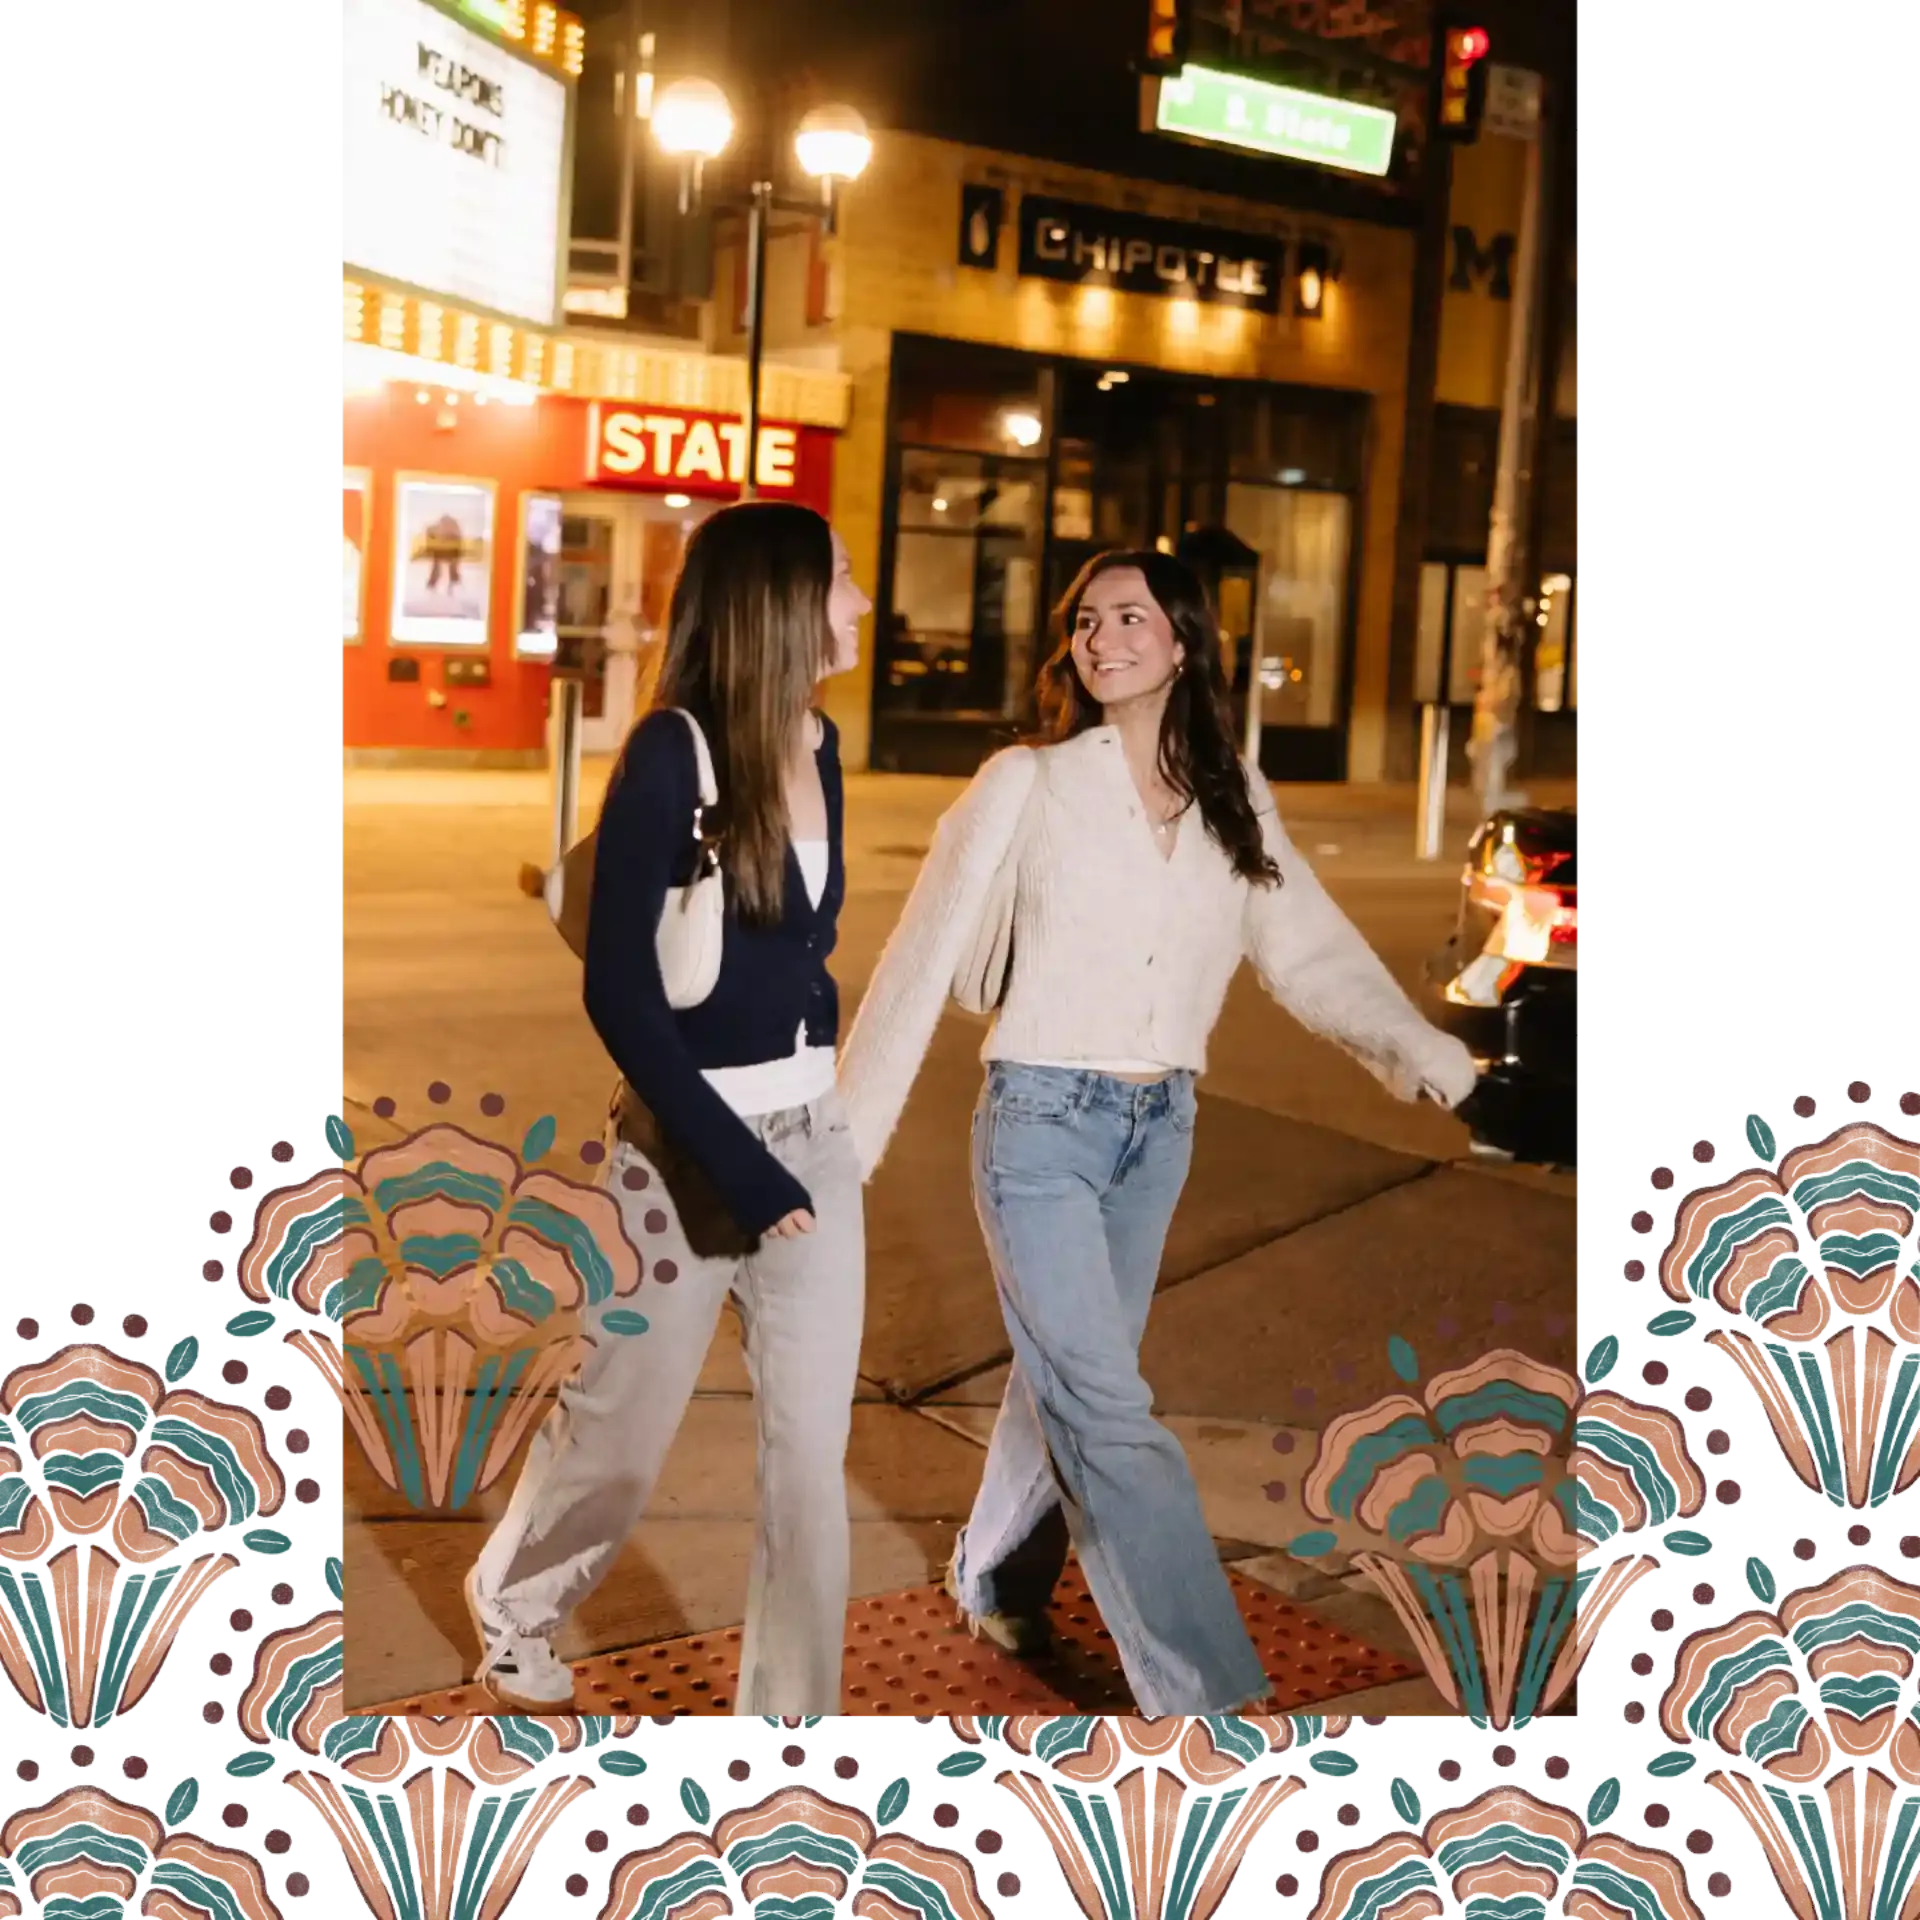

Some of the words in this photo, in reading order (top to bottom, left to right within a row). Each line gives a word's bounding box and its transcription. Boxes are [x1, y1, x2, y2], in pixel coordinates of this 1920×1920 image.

[380, 81, 444, 140] HONEY
[417, 40, 503, 118] WEAPONS
[1265, 103, 1351, 150] State
[1035, 217, 1270, 297] CHIPOTLE
[602, 412, 797, 487] STATE
